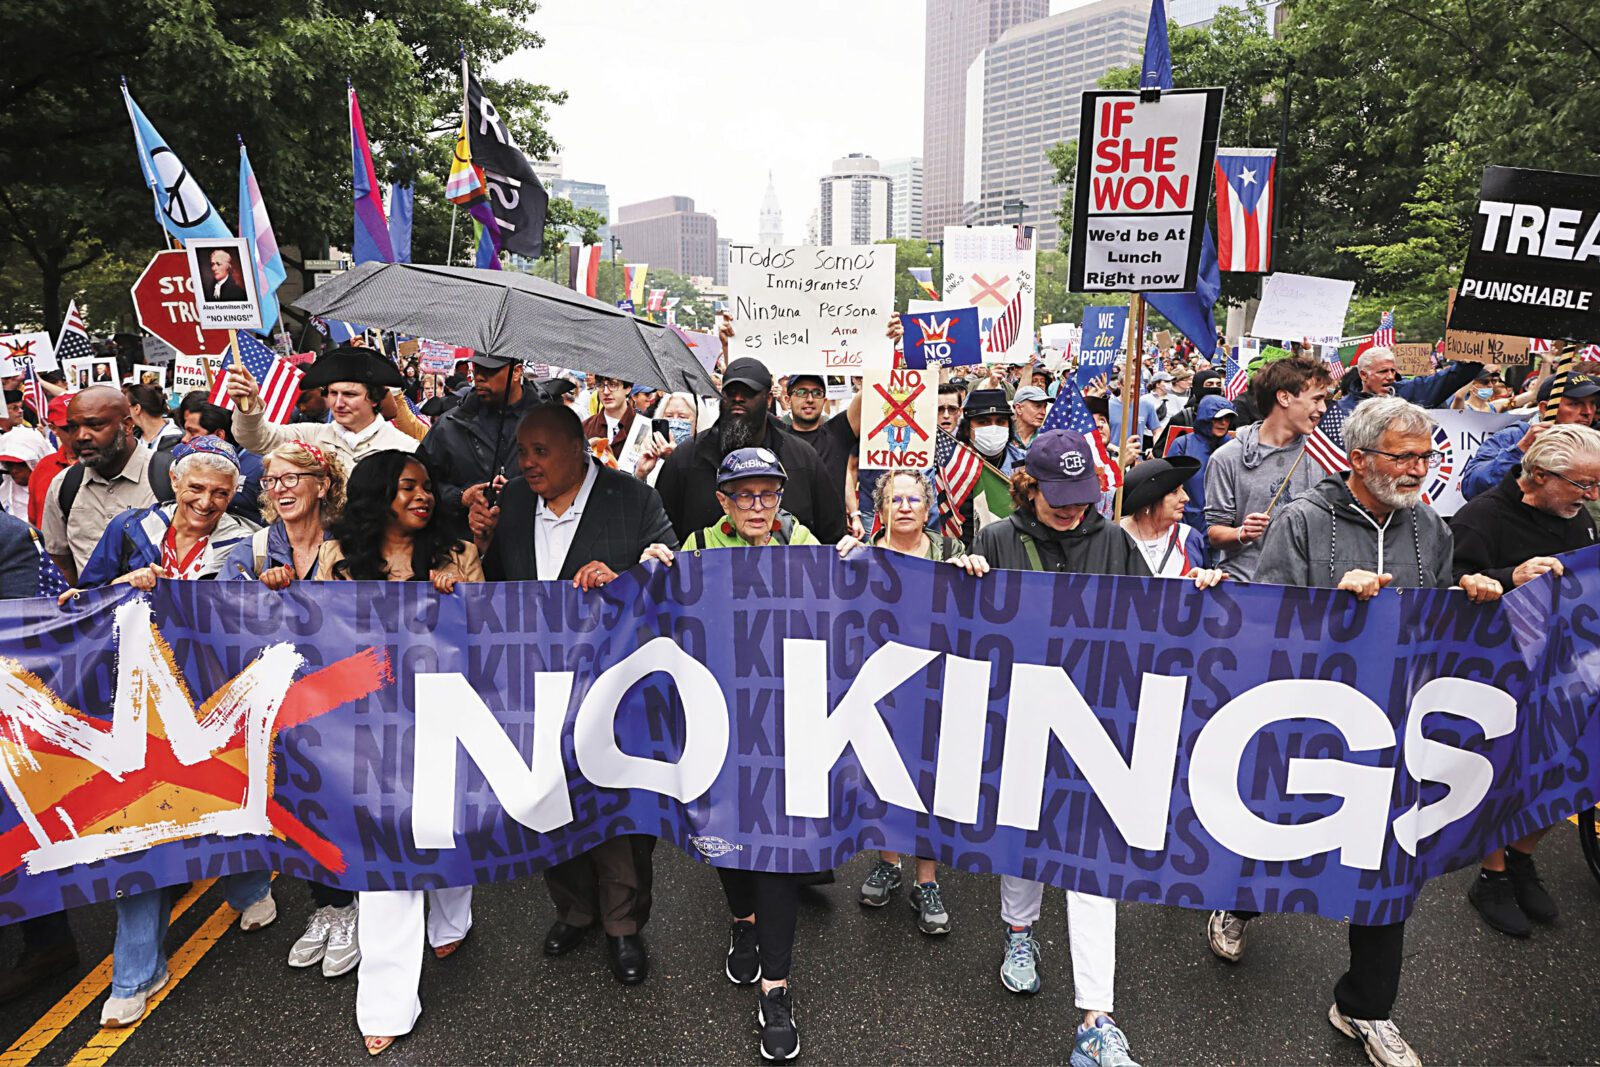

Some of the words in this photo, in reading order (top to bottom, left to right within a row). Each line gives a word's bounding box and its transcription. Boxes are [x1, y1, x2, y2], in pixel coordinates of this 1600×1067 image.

[1101, 102, 1135, 138] IF
[1095, 136, 1178, 174] SHE
[1093, 175, 1189, 211] WON
[1088, 230, 1131, 242] We’d
[1137, 230, 1158, 242] be
[1165, 229, 1186, 241] At
[1107, 251, 1162, 263] Lunch
[766, 273, 863, 293] Inmigrantes!
[945, 273, 955, 282] NO
[1019, 270, 1031, 280] NO
[1086, 272, 1135, 287] Right
[1141, 274, 1179, 284] now
[1460, 278, 1593, 310] PUNISHABLE
[736, 295, 801, 321] Ninguna
[1098, 313, 1115, 329] WE
[745, 333, 762, 348] es
[773, 328, 810, 346] ilegal
[831, 325, 858, 336] Ama
[1093, 331, 1115, 347] the
[822, 349, 863, 366] Todos
[924, 343, 951, 359] NO
[889, 370, 922, 388] NO
[866, 450, 928, 468] KINGS
[731, 546, 903, 601] KINGS
[932, 570, 1022, 625] NO
[1050, 572, 1243, 640] KINGS
[1274, 588, 1368, 643] NO
[412, 636, 730, 849] NO
[783, 637, 1518, 871] KINGS
